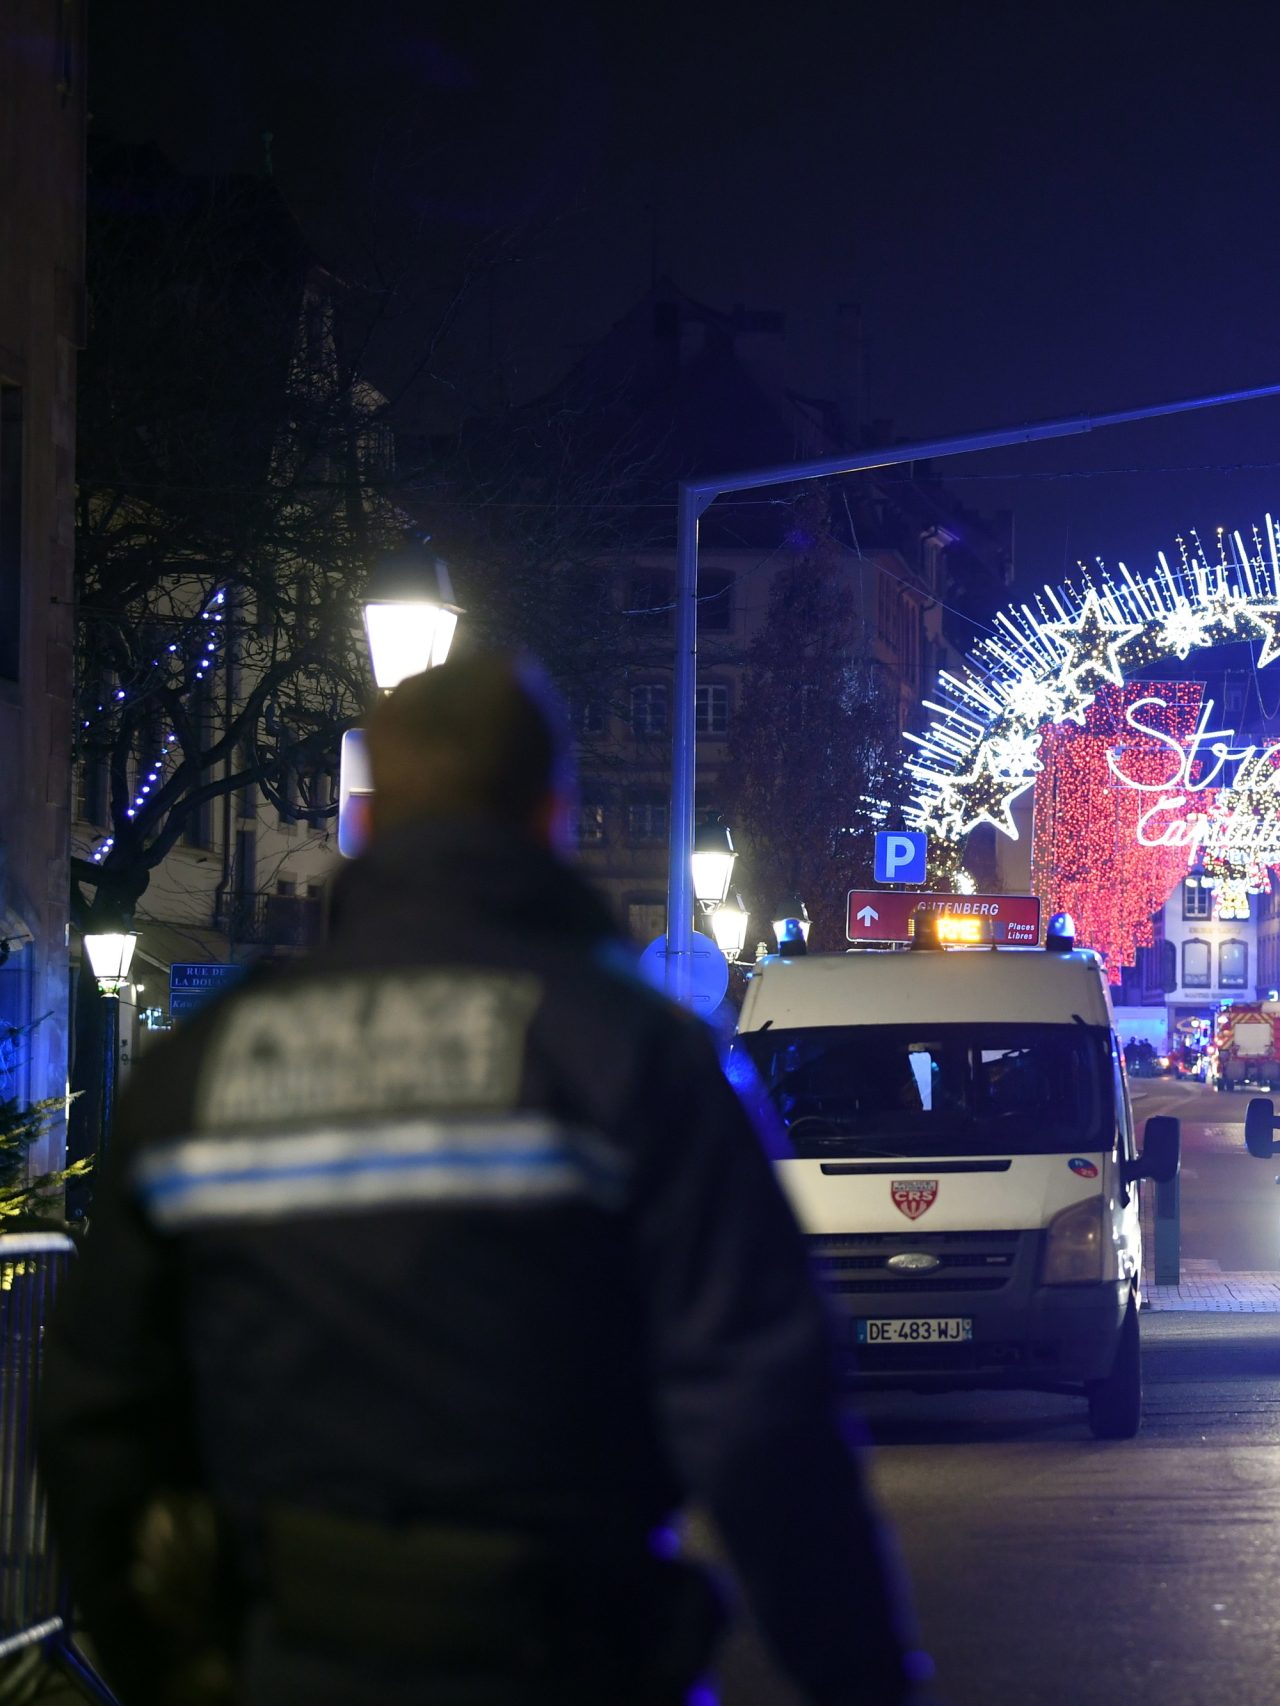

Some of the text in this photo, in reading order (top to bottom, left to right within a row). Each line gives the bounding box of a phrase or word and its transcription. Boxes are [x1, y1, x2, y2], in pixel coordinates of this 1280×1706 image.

[886, 836, 916, 878] P
[1007, 922, 1035, 931] Places
[1007, 931, 1033, 940] Libres
[187, 967, 226, 976] RUE DE
[175, 977, 189, 986] LA
[894, 1190, 934, 1202] CRS
